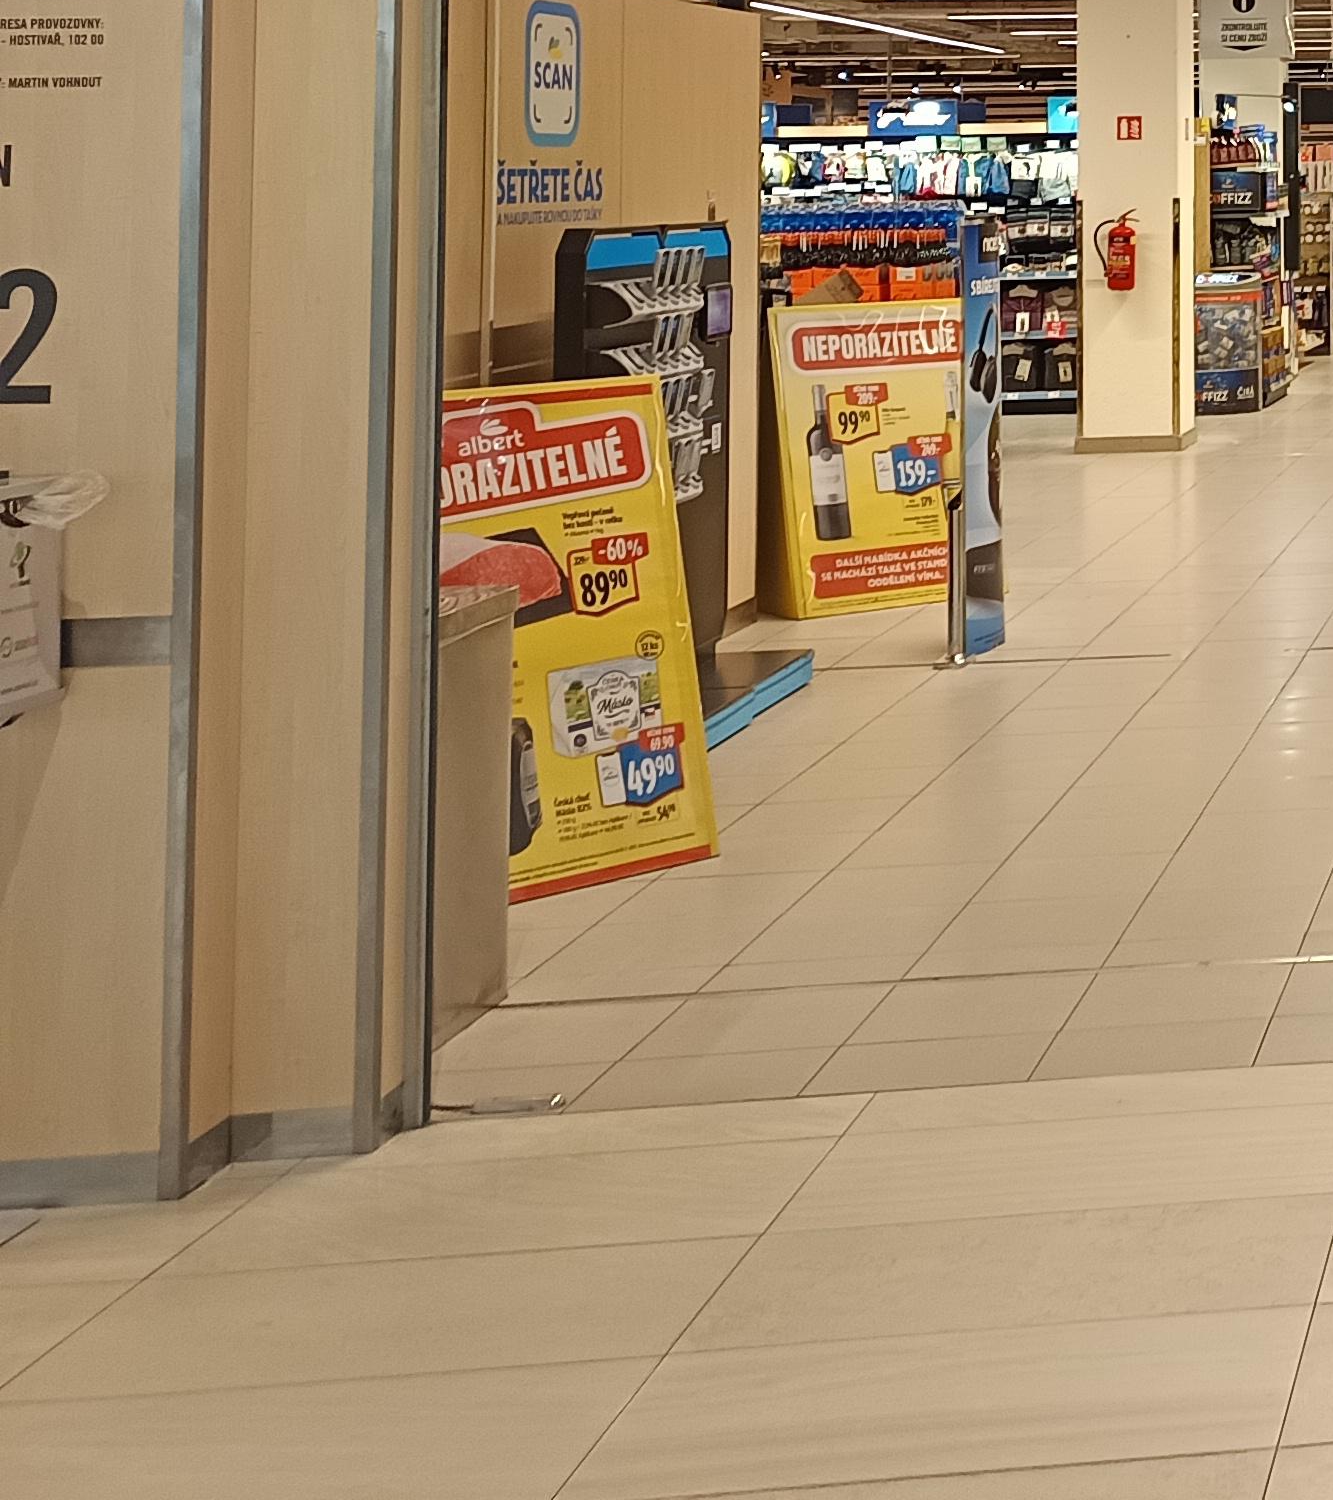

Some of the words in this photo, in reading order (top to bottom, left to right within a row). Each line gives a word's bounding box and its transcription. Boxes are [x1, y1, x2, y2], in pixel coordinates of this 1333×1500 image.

[31, 18, 104, 30] PROVOZOVNY:
[9, 33, 65, 46] HOSTIVAŘ,
[69, 34, 87, 45] 102
[90, 34, 104, 45] 00
[8, 77, 49, 88] MARTIN
[52, 76, 102, 88] VOHNOUT
[534, 60, 573, 90] SCAN
[497, 159, 570, 205] ŠETŘETE
[574, 160, 603, 202] ČAS
[0, 269, 58, 404] 2
[802, 322, 958, 362] NEPORAZITELNÉ
[458, 429, 525, 457] albert
[598, 537, 644, 562] -60%
[597, 696, 634, 714] Máslo
